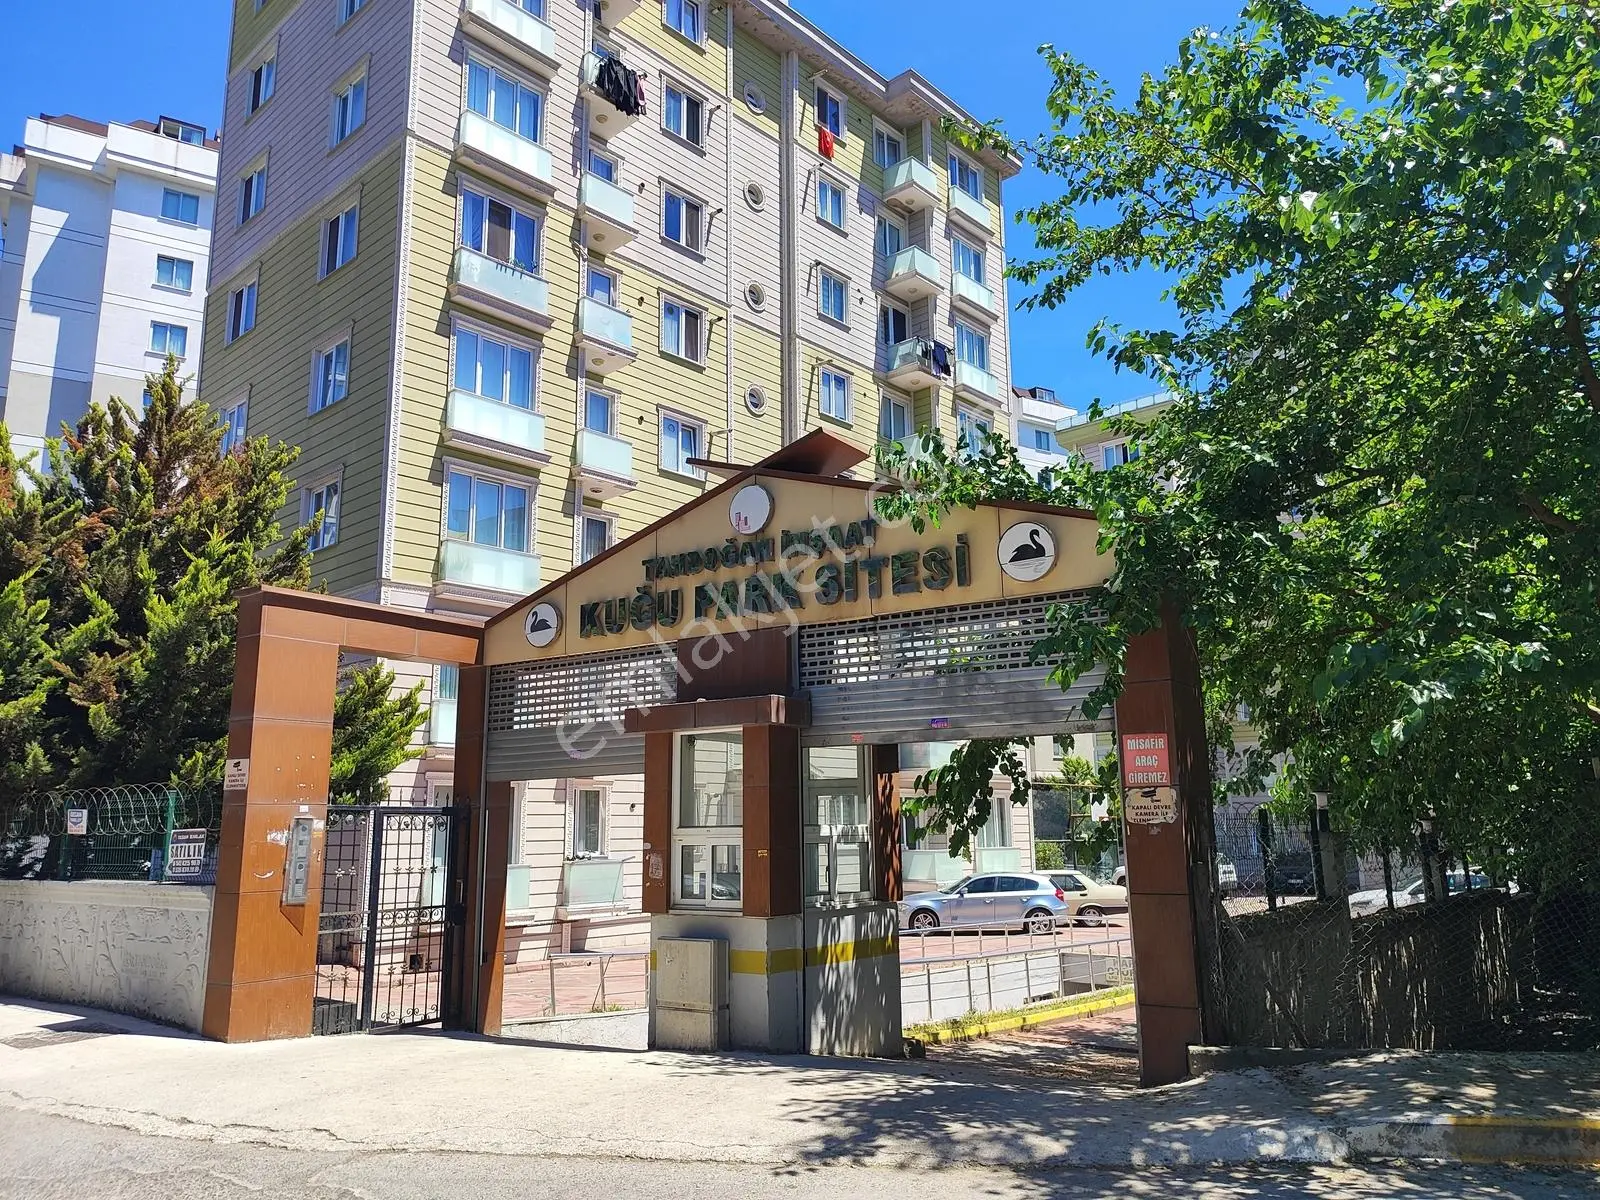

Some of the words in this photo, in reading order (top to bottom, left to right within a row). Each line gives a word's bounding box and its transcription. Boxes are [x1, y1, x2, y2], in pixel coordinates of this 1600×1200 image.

[579, 585, 684, 639] KUĞU
[694, 573, 804, 622] PARK
[1127, 736, 1164, 750] MİSAFİR
[1135, 755, 1158, 768] ARAÇ
[1128, 771, 1167, 783] GİREMEZ
[171, 845, 203, 858] SATILIK
